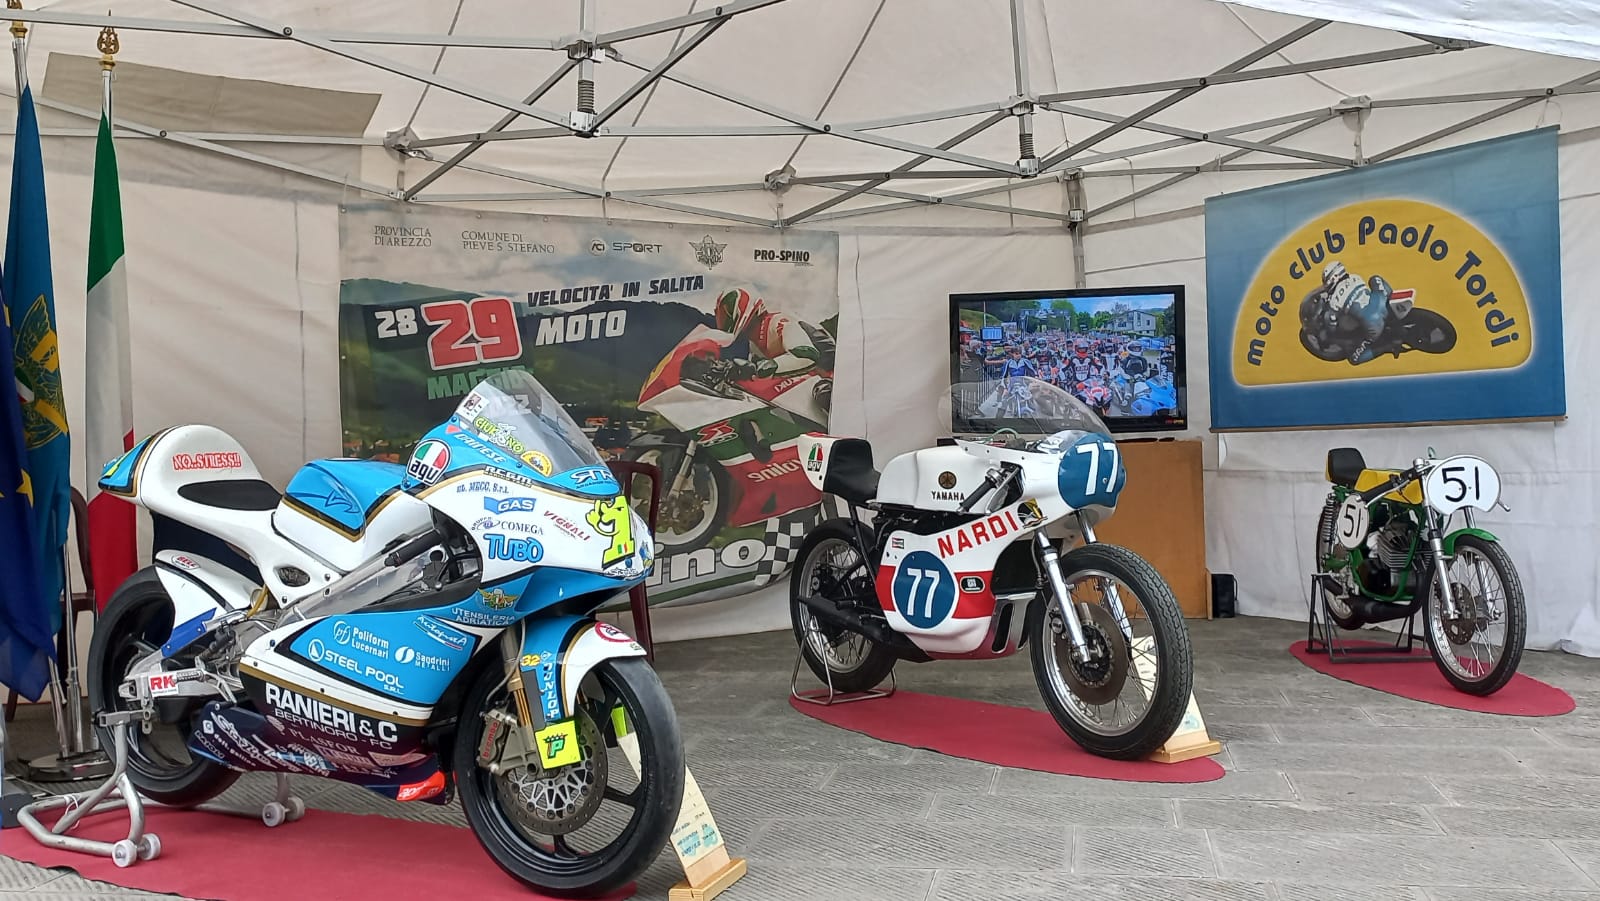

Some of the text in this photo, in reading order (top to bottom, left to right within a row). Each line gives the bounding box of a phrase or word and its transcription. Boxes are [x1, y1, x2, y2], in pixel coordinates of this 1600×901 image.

[374, 225, 432, 237] PROVINCIA
[374, 236, 432, 247] DI AREZZO
[461, 230, 523, 242] COMUNE DI
[463, 240, 494, 251] PIEVE
[508, 242, 555, 254] STEFANO
[612, 242, 663, 254] SPORT
[754, 249, 810, 262] PRO-SPINO
[622, 281, 640, 299] IN
[649, 275, 704, 295] SALITA
[1247, 284, 1285, 366] moto
[1289, 229, 1345, 280] club
[1358, 215, 1449, 261] Paolo
[1455, 250, 1520, 347] Tordi
[374, 297, 523, 371] 28 29
[534, 309, 627, 347] MOTO
[1076, 442, 1119, 496] 77
[1441, 466, 1481, 503] 51
[498, 500, 534, 512] GAS
[931, 491, 965, 501] YAMAHA
[501, 520, 544, 536] COMEGA
[544, 510, 591, 541] VIGNALI
[1343, 504, 1362, 539] 51
[937, 510, 1019, 559] NARDI
[906, 568, 940, 618] 77
[452, 607, 515, 620] UTENSILERIA
[351, 638, 389, 659] Lucernari
[353, 627, 389, 648] Poliform
[324, 649, 404, 689] STEEL POOL
[415, 661, 450, 671] METALLI
[520, 655, 541, 667] 32
[150, 675, 176, 690] RK
[543, 662, 560, 718] DUNLOP
[265, 682, 398, 743] RANIERI & C
[274, 709, 358, 742] BERTINORO
[370, 738, 393, 750] FC
[482, 722, 499, 759] brembo
